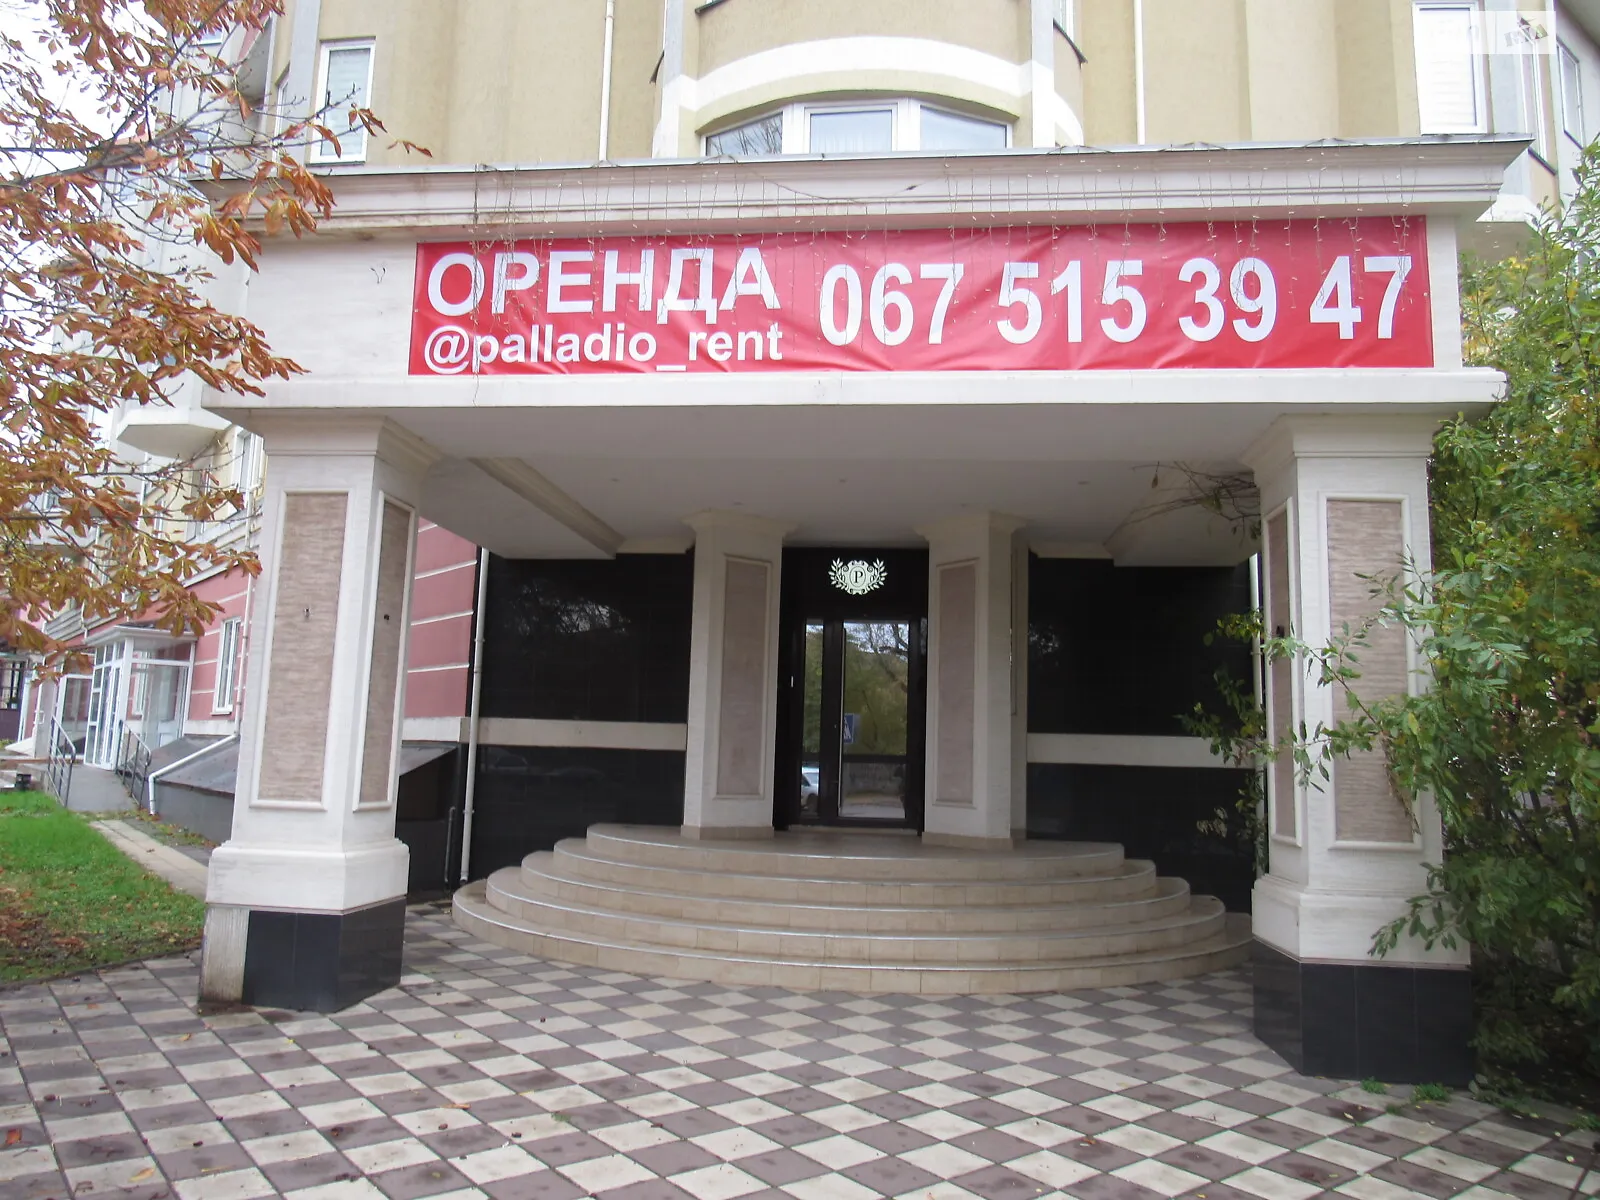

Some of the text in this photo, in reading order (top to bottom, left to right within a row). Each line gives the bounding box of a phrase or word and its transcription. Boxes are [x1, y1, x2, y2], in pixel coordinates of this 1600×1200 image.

[427, 247, 782, 325] ОРЕНДА
[818, 255, 1413, 347] 067 515 39 47
[424, 322, 784, 375] @palladio_rent
[853, 570, 864, 584] P
